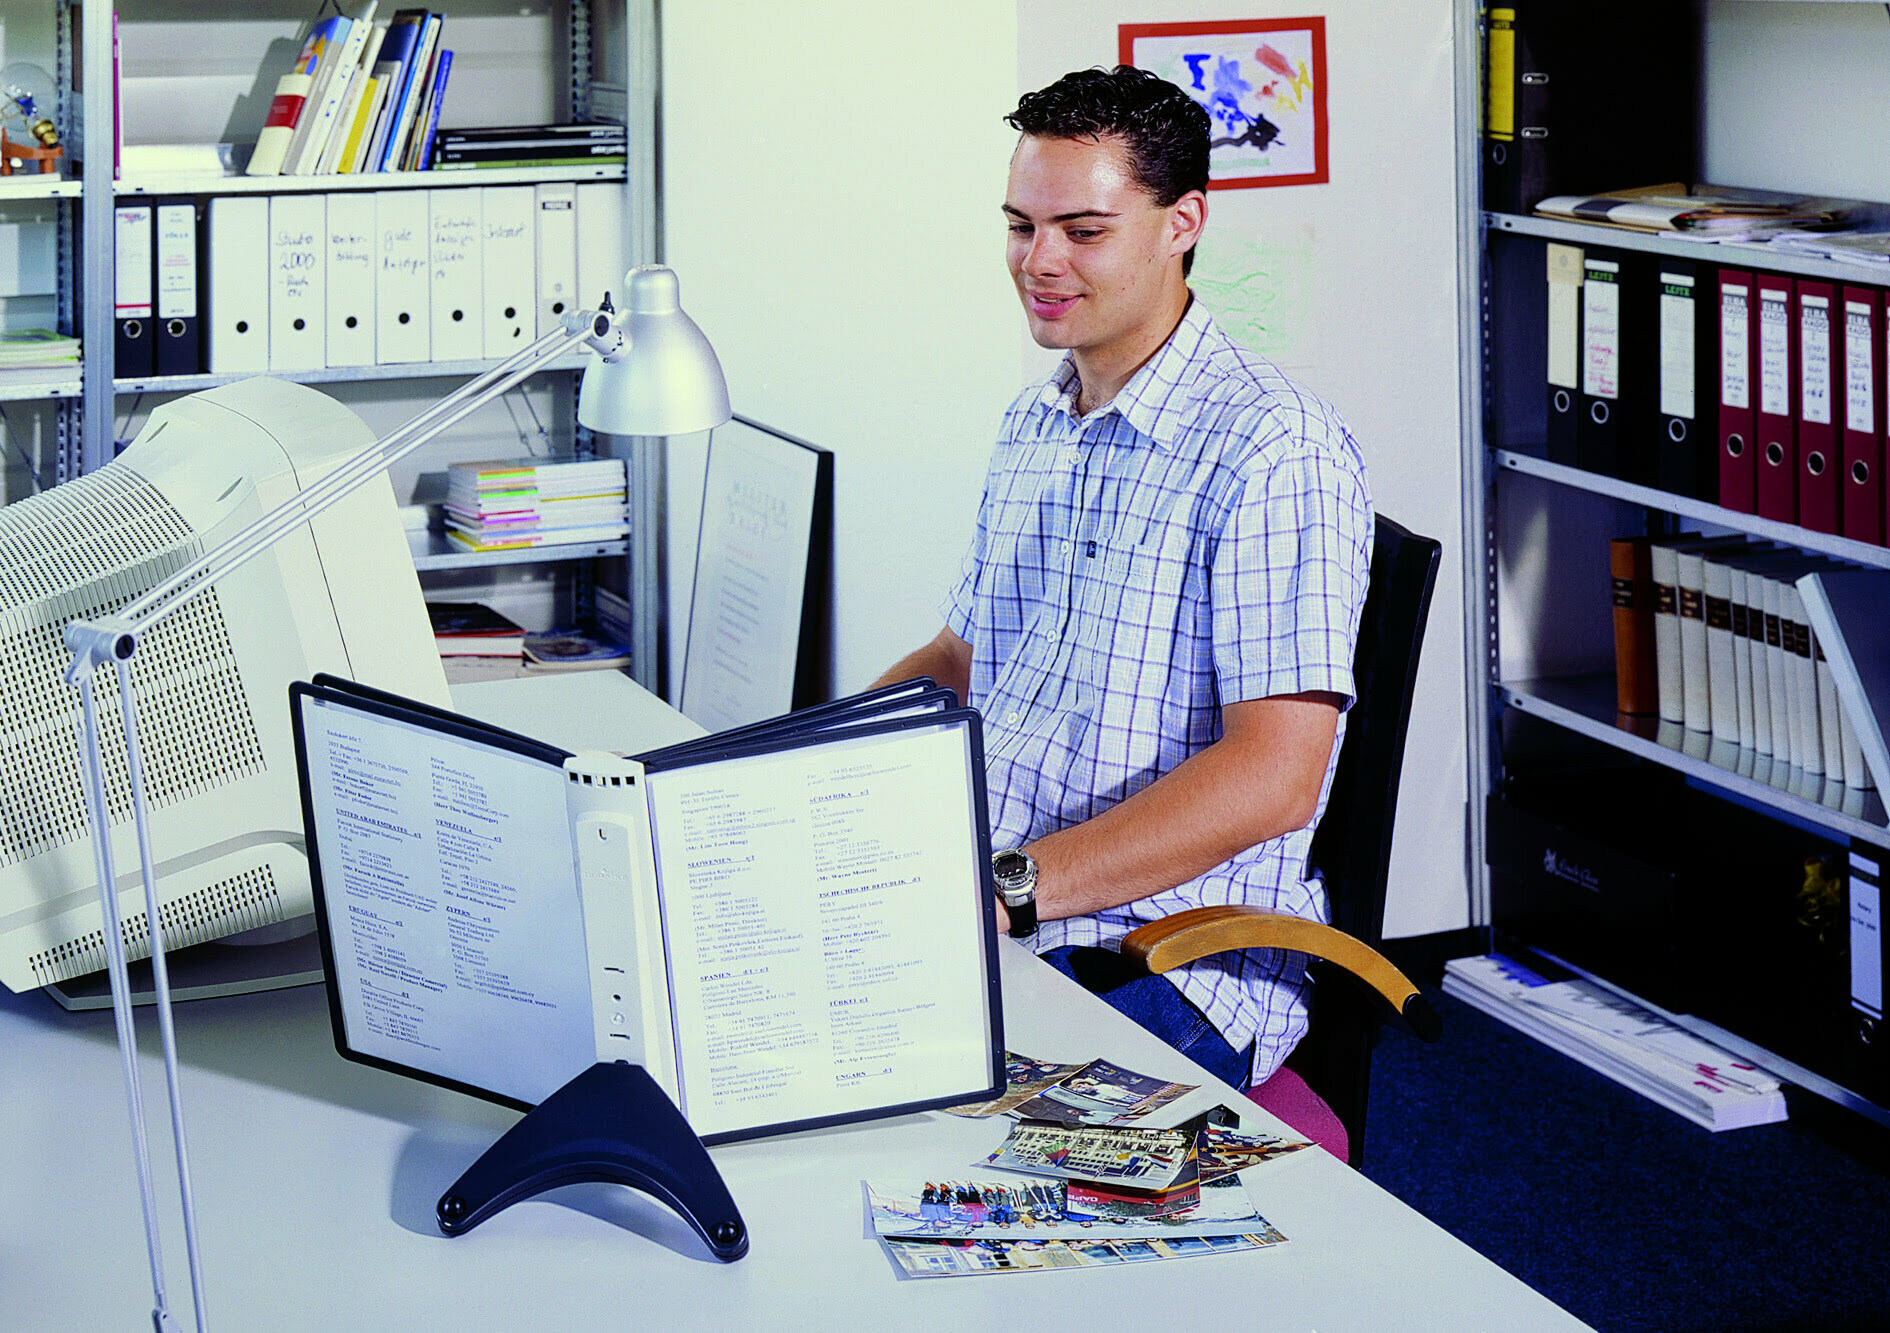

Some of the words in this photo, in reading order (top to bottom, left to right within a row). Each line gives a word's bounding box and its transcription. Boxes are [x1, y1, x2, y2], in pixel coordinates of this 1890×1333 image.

[336, 807, 358, 819] UNITED
[360, 815, 375, 824] ARAB
[377, 820, 406, 834] EMIRATES
[435, 818, 472, 834] VENEZUELA
[687, 857, 731, 868] SLOWENIEN
[700, 972, 730, 981] SPANIEN
